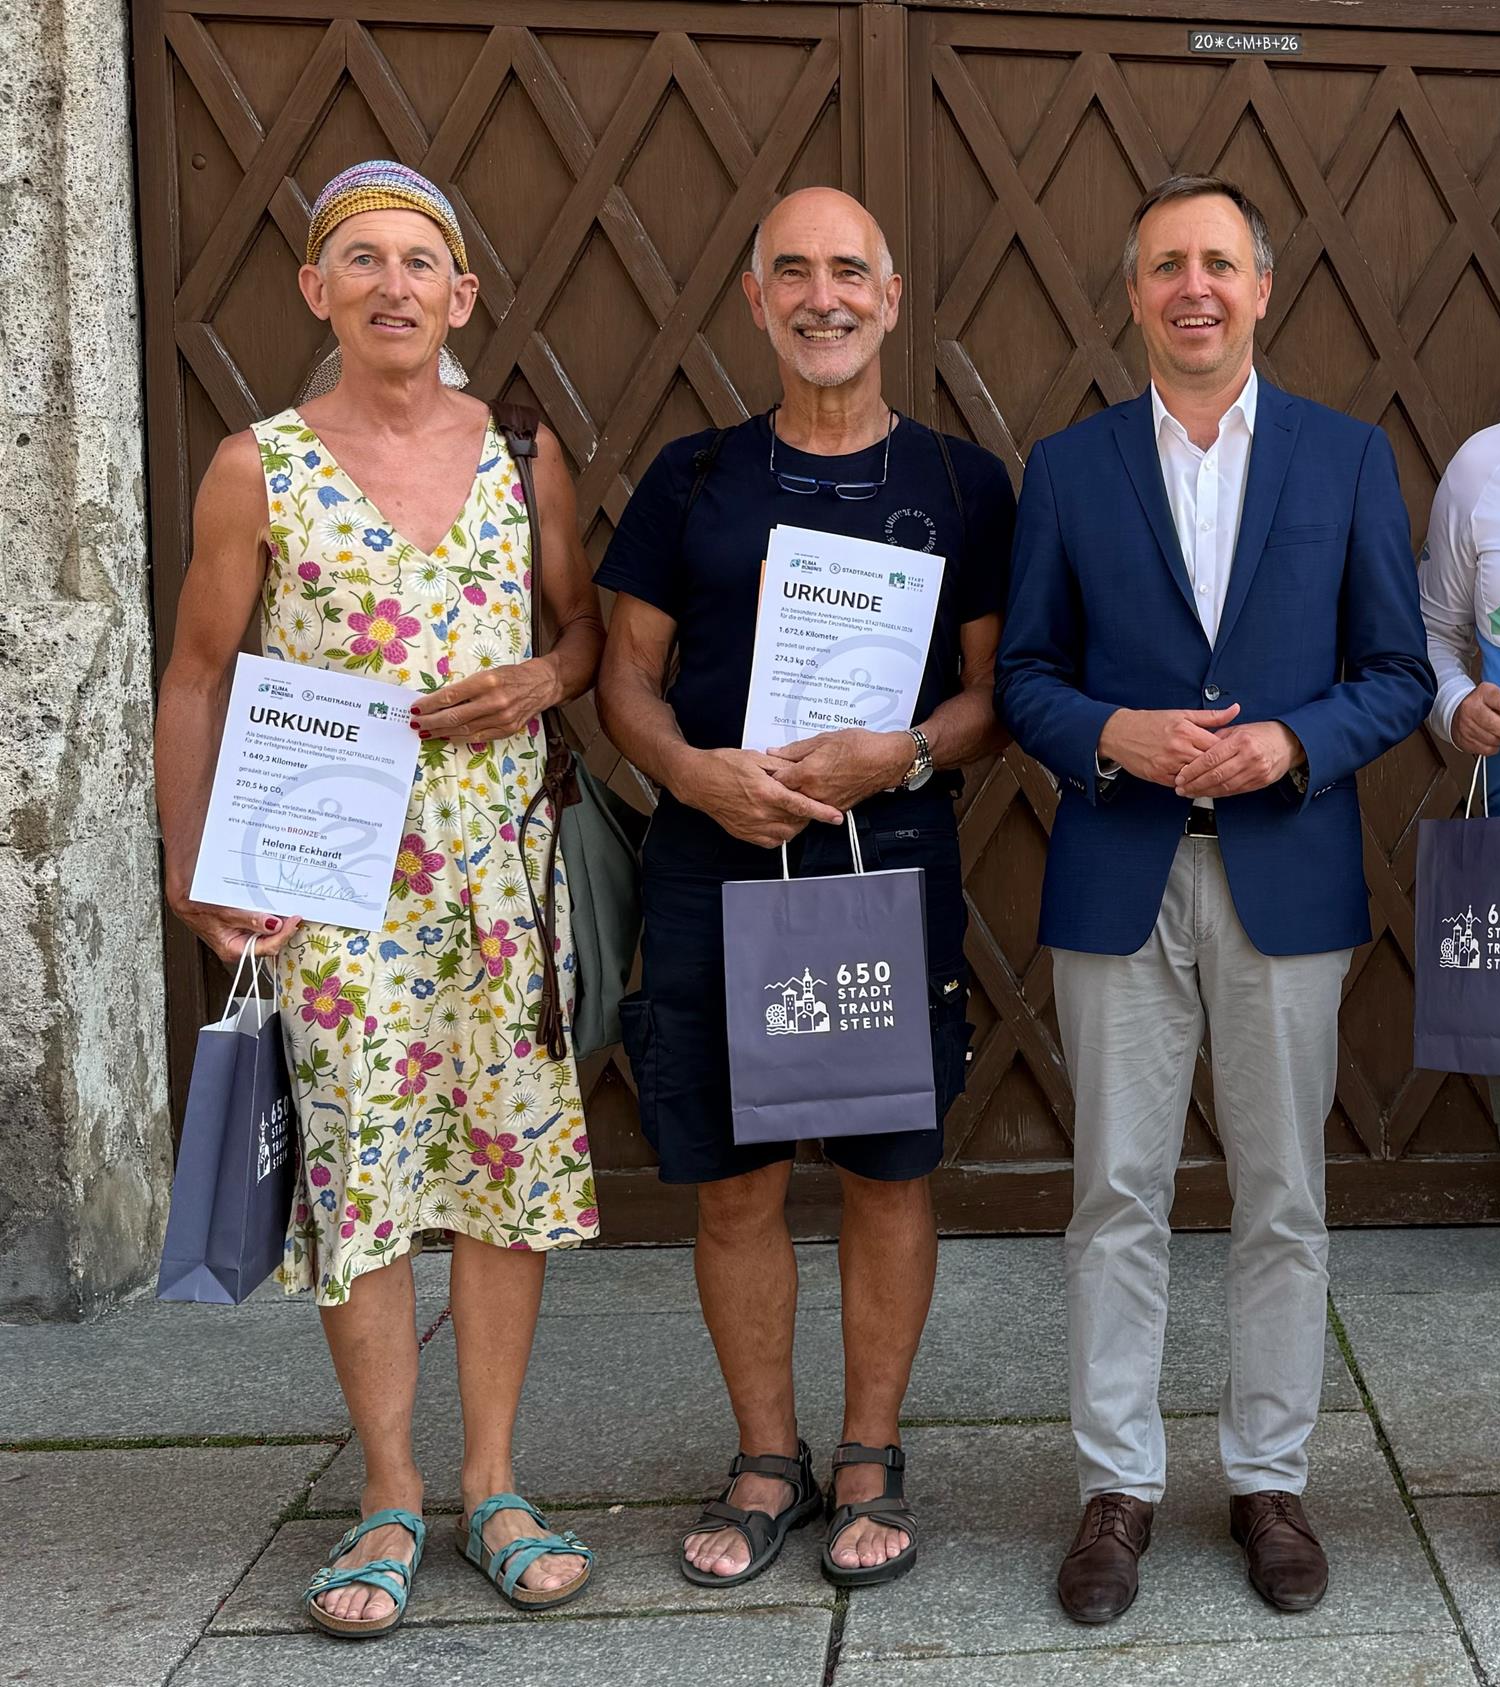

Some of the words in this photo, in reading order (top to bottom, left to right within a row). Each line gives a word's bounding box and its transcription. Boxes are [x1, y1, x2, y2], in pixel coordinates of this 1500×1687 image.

[842, 567, 884, 579] STADTRADELN
[783, 581, 883, 613] URKUNDE
[805, 630, 839, 641] Kilometer
[795, 656, 805, 666] kg
[315, 694, 362, 710] STADTRADELN
[823, 697, 849, 707] SILBER
[249, 705, 361, 743] URKUNDE
[808, 710, 832, 722] Marc
[834, 714, 867, 727] Stocker
[271, 756, 308, 770] Kilometer
[236, 779, 258, 790] 270,5
[258, 782, 269, 793] kg
[287, 826, 320, 839] BRONZE
[262, 838, 297, 852] Helena
[299, 844, 342, 860] Eckhardt
[836, 961, 891, 985] 650
[838, 984, 892, 1000] STADT
[838, 1000, 893, 1015] TRAUN
[839, 1016, 895, 1031] STEIN
[271, 1095, 289, 1124] 650
